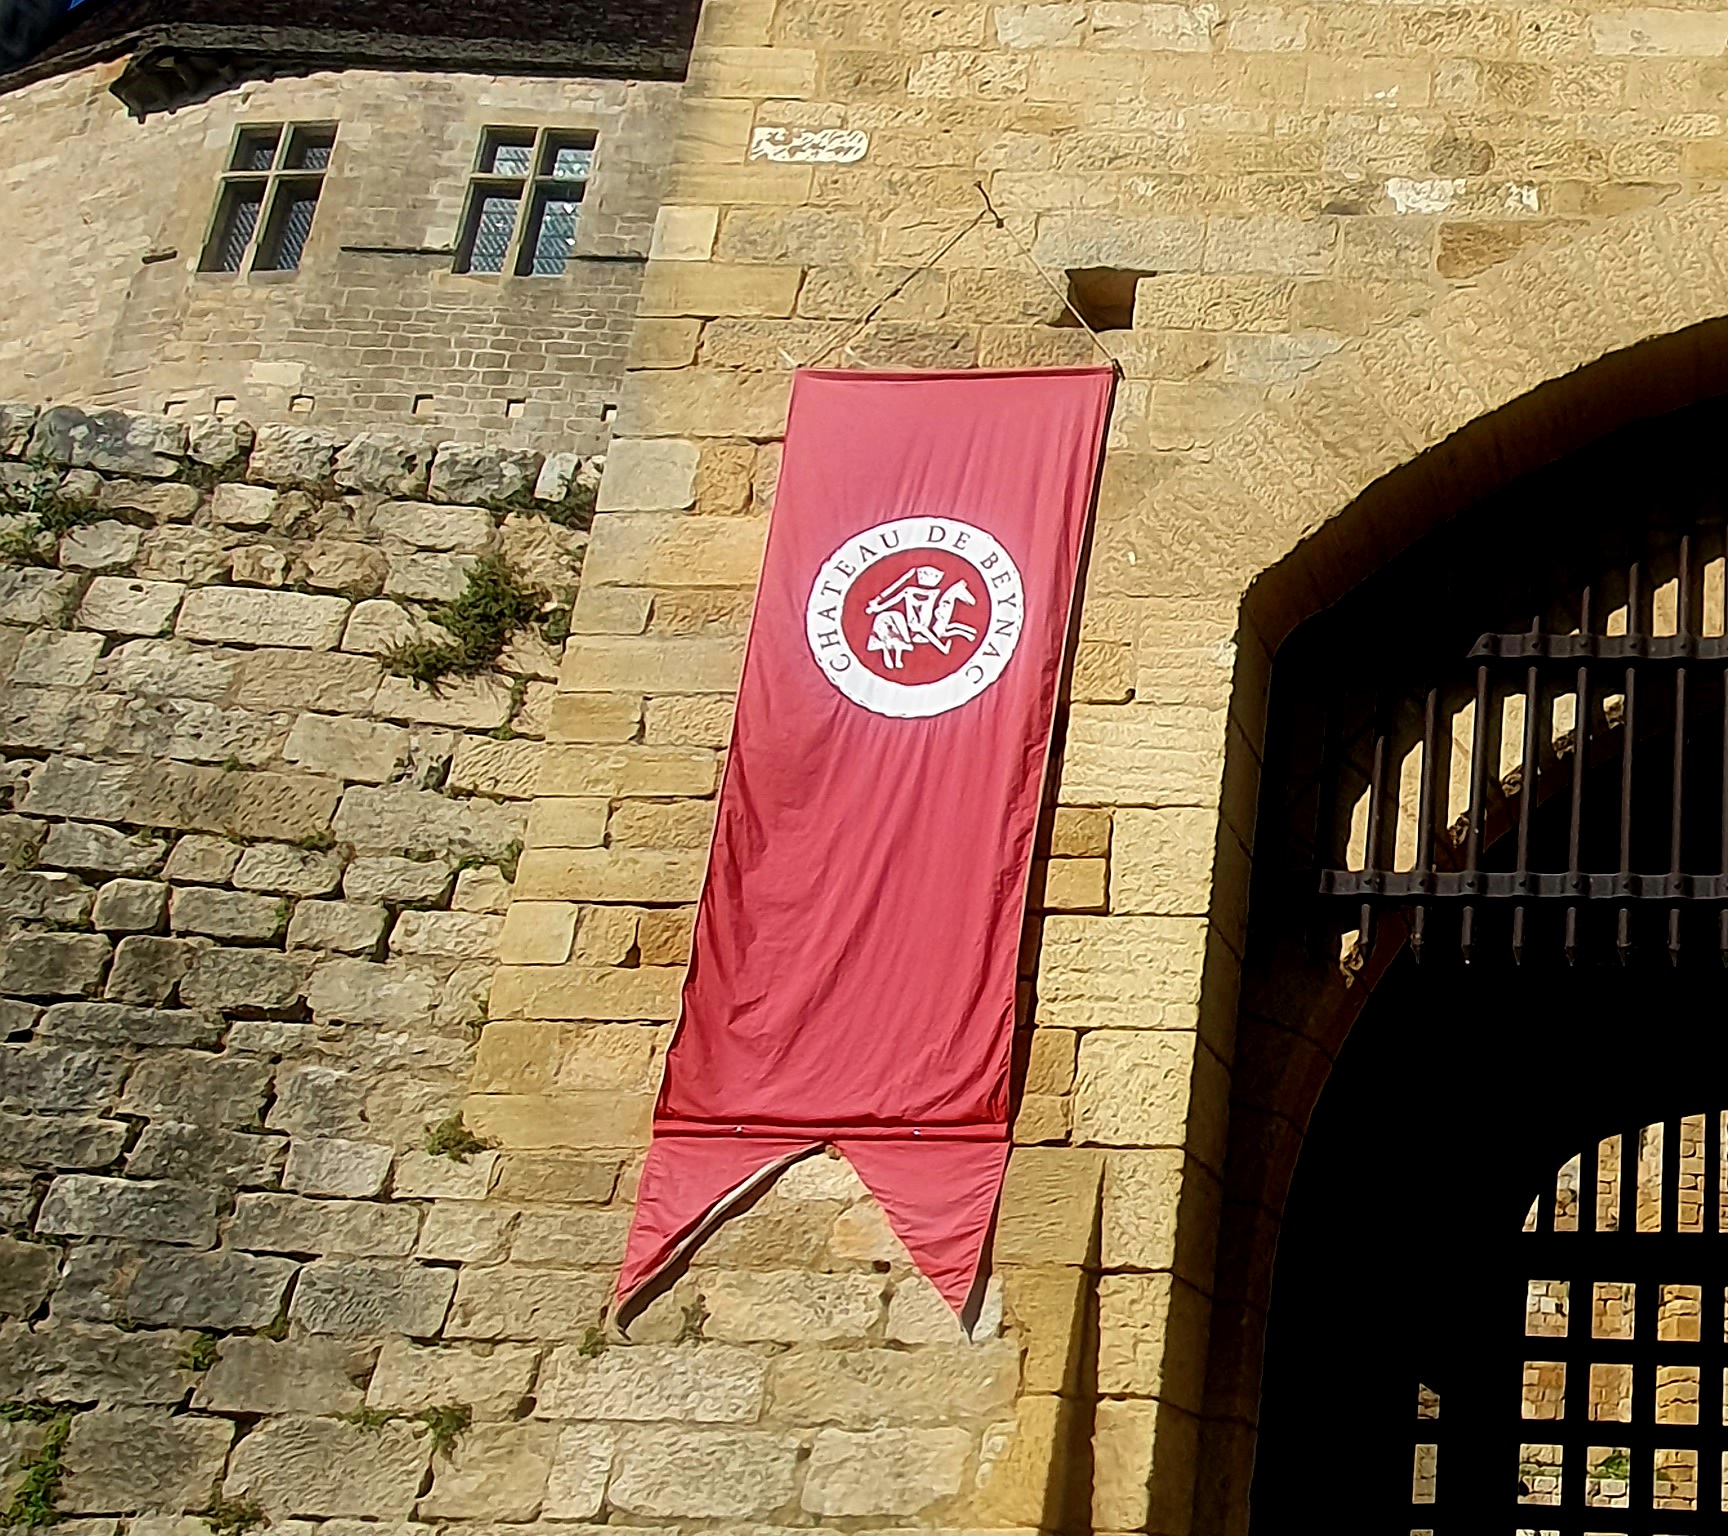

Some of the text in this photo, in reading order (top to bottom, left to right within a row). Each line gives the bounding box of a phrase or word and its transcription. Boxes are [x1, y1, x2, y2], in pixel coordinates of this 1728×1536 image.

[817, 524, 1016, 685] CHATEAU DE BEYNAC
